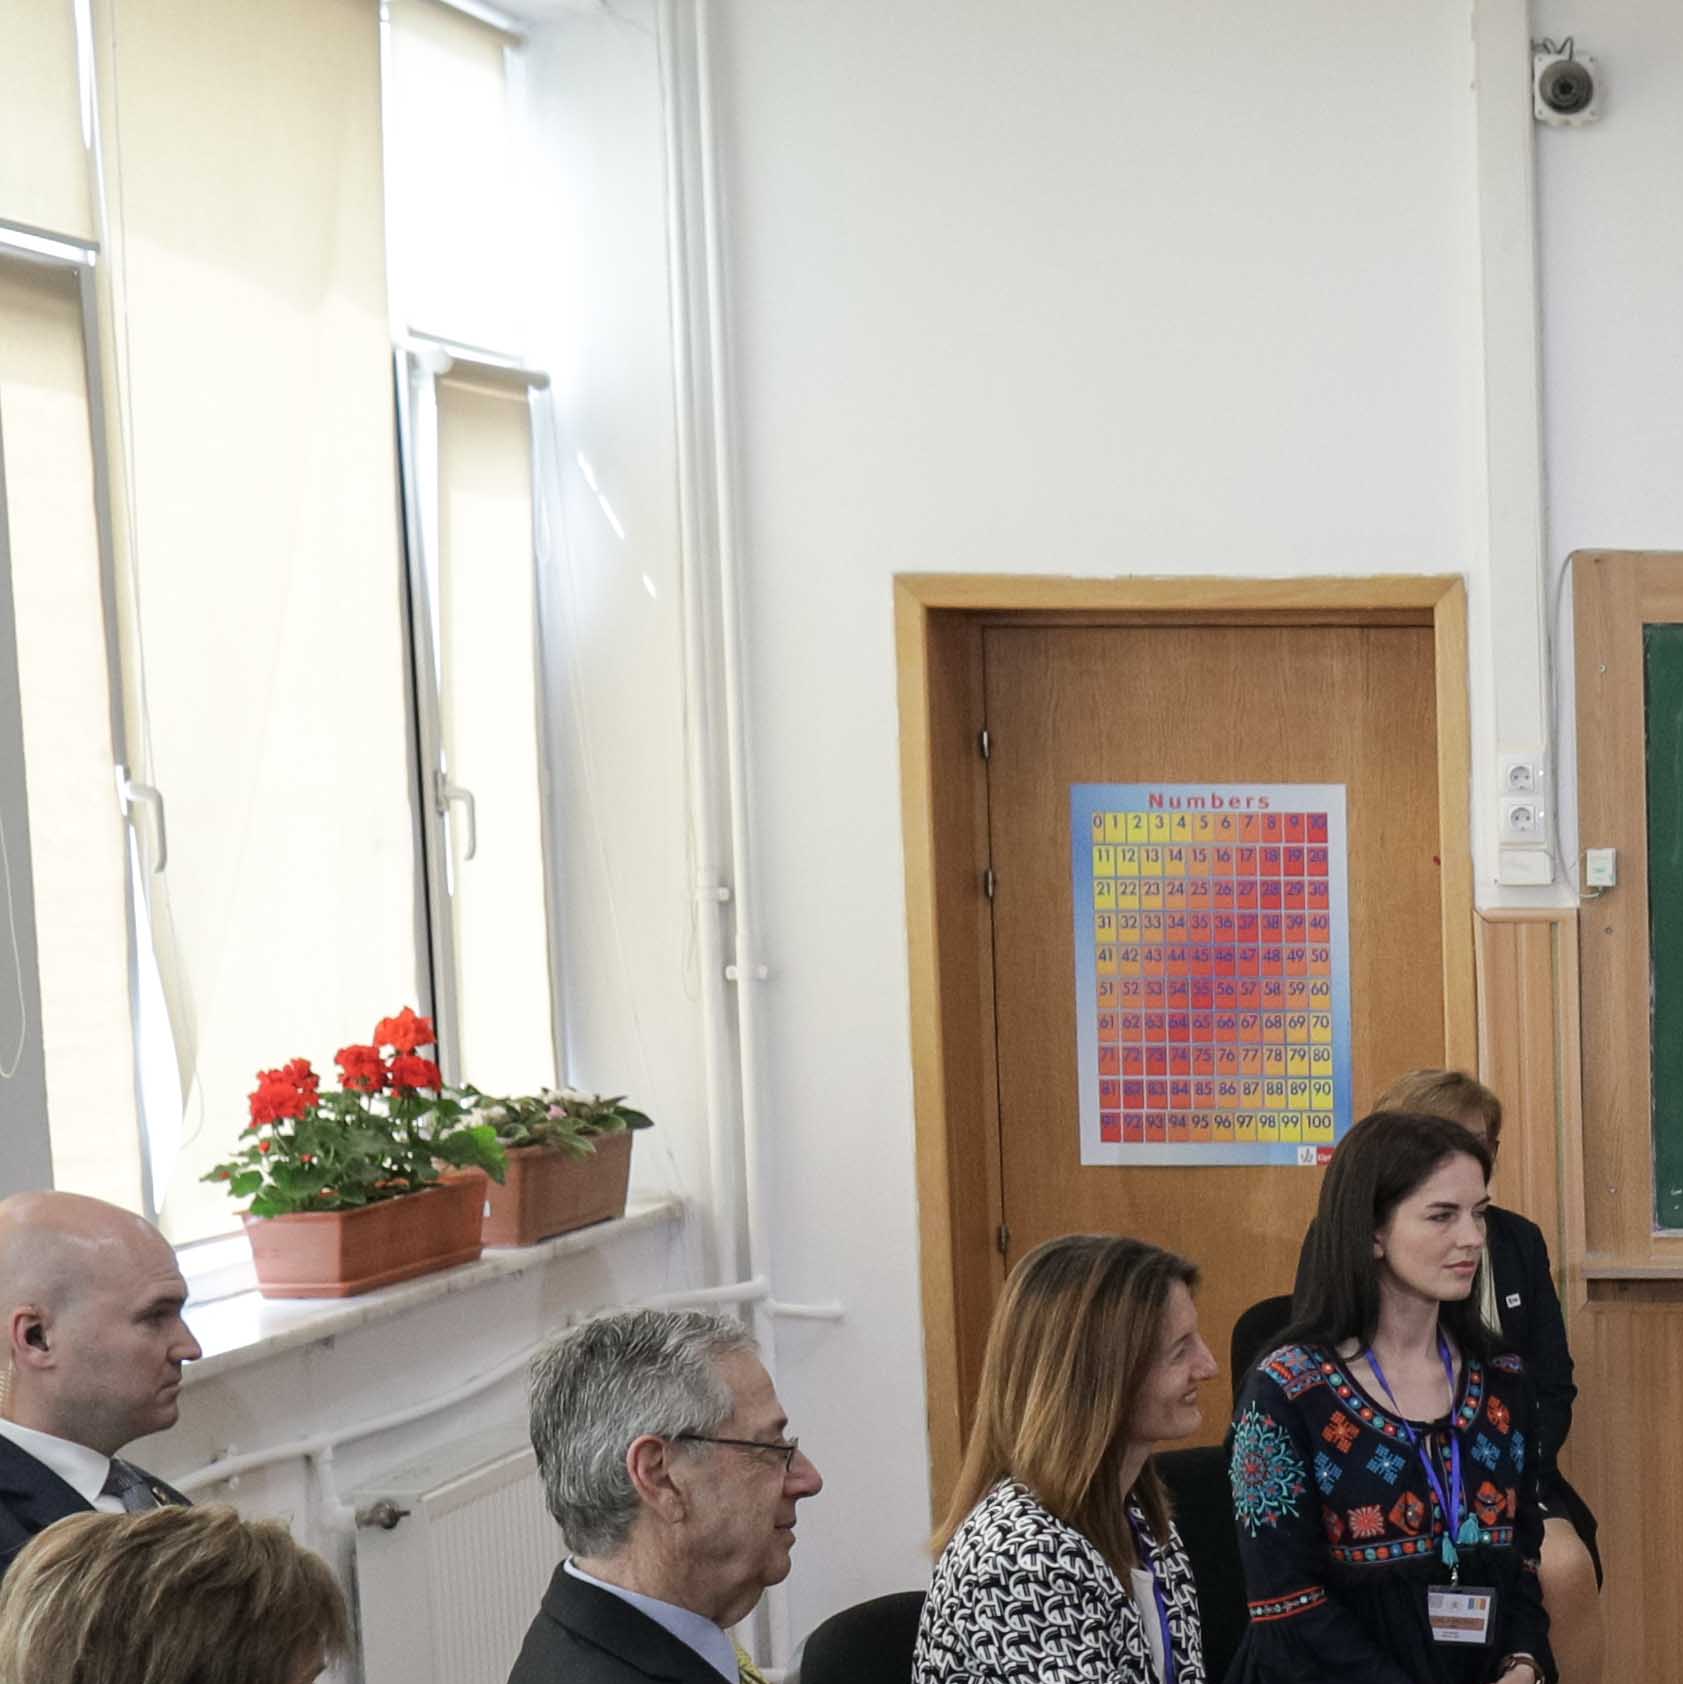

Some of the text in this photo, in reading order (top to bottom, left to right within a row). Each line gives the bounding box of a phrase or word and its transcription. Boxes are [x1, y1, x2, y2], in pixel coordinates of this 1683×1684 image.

[1148, 792, 1270, 809] Numbers
[1093, 815, 1102, 828] 0
[1112, 815, 1117, 828] 1
[1133, 815, 1142, 828] 2
[1155, 815, 1164, 828] 3
[1177, 815, 1186, 828] 4
[1201, 815, 1208, 828] 5
[1221, 815, 1231, 828] 6
[1245, 815, 1254, 828] 7
[1098, 848, 1110, 862] 11
[1122, 848, 1135, 862] 12
[1146, 848, 1159, 862] 13
[1169, 848, 1183, 862] 14
[1193, 848, 1207, 862] 15
[1216, 848, 1231, 862] 16
[1240, 848, 1253, 862] 17
[1096, 882, 1111, 896] 21
[1120, 882, 1137, 896] 22
[1144, 882, 1160, 896] 23
[1168, 882, 1184, 896] 24
[1192, 882, 1208, 896] 25
[1098, 915, 1111, 928] 31
[1120, 915, 1137, 928] 32
[1144, 915, 1161, 928] 33
[1168, 915, 1185, 928] 34
[1311, 915, 1328, 928] 40
[1099, 949, 1112, 962] 41
[1122, 949, 1138, 962] 42
[1312, 949, 1328, 962] 50
[1101, 982, 1113, 995] 51
[1217, 982, 1234, 995] 56
[1241, 982, 1257, 995] 57
[1264, 982, 1280, 995] 58
[1289, 982, 1305, 995] 59
[1311, 982, 1329, 995] 60
[1241, 1015, 1257, 1029] 67
[1265, 1015, 1282, 1029] 68
[1289, 1015, 1306, 1029] 69
[1313, 1015, 1330, 1029] 70
[1219, 1049, 1235, 1062] 76
[1242, 1049, 1258, 1062] 77
[1266, 1049, 1282, 1062] 78
[1289, 1049, 1306, 1062] 79
[1313, 1049, 1330, 1062] 80
[1219, 1082, 1236, 1096] 86
[1243, 1082, 1259, 1096] 87
[1266, 1082, 1283, 1096] 88
[1290, 1082, 1307, 1096] 89
[1313, 1082, 1331, 1096] 90
[1192, 1115, 1209, 1129] 95
[1214, 1115, 1231, 1129] 96
[1236, 1115, 1253, 1129] 97
[1259, 1115, 1276, 1129] 98
[1281, 1115, 1299, 1129] 99
[1307, 1115, 1331, 1129] 100
